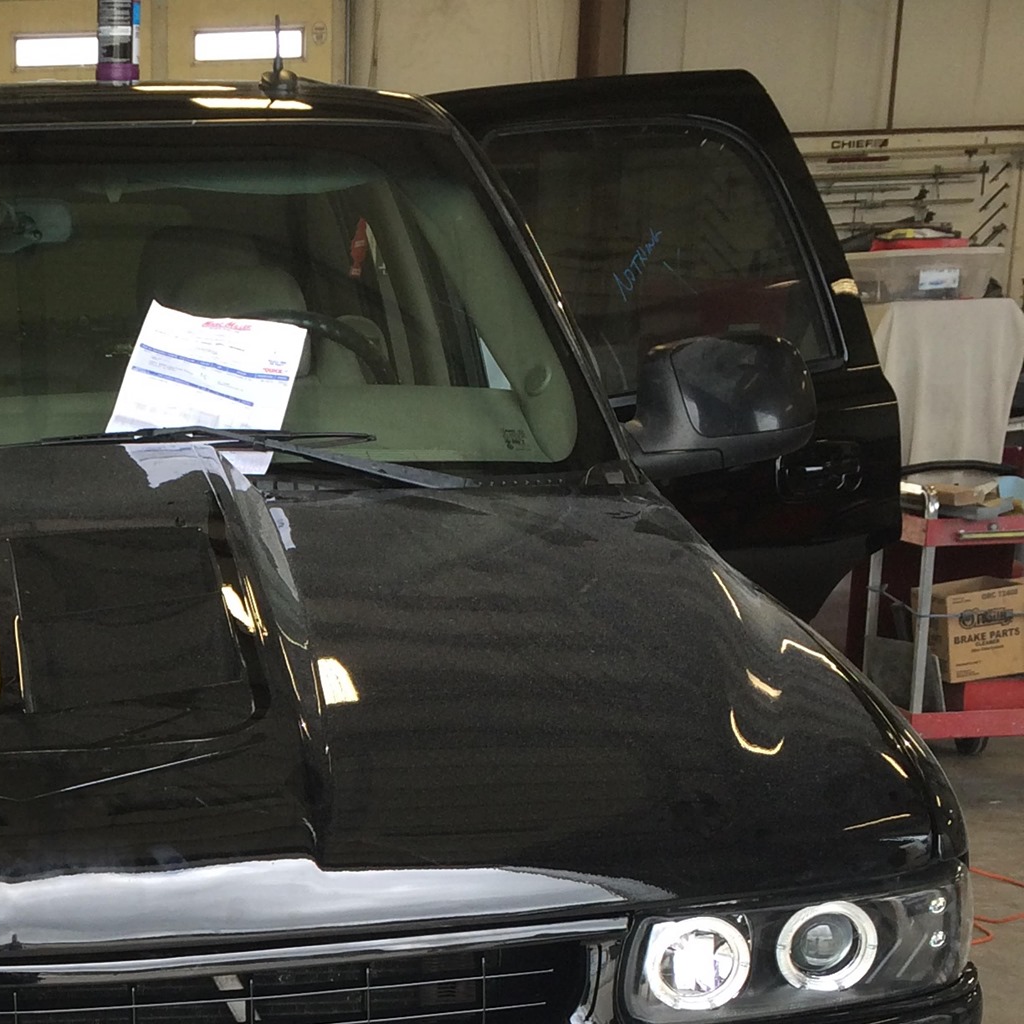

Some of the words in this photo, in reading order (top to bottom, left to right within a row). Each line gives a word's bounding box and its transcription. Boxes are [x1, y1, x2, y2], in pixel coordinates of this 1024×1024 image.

[831, 139, 873, 149] CHIEF
[954, 632, 986, 645] BRAKE
[989, 627, 1021, 639] PARTS
